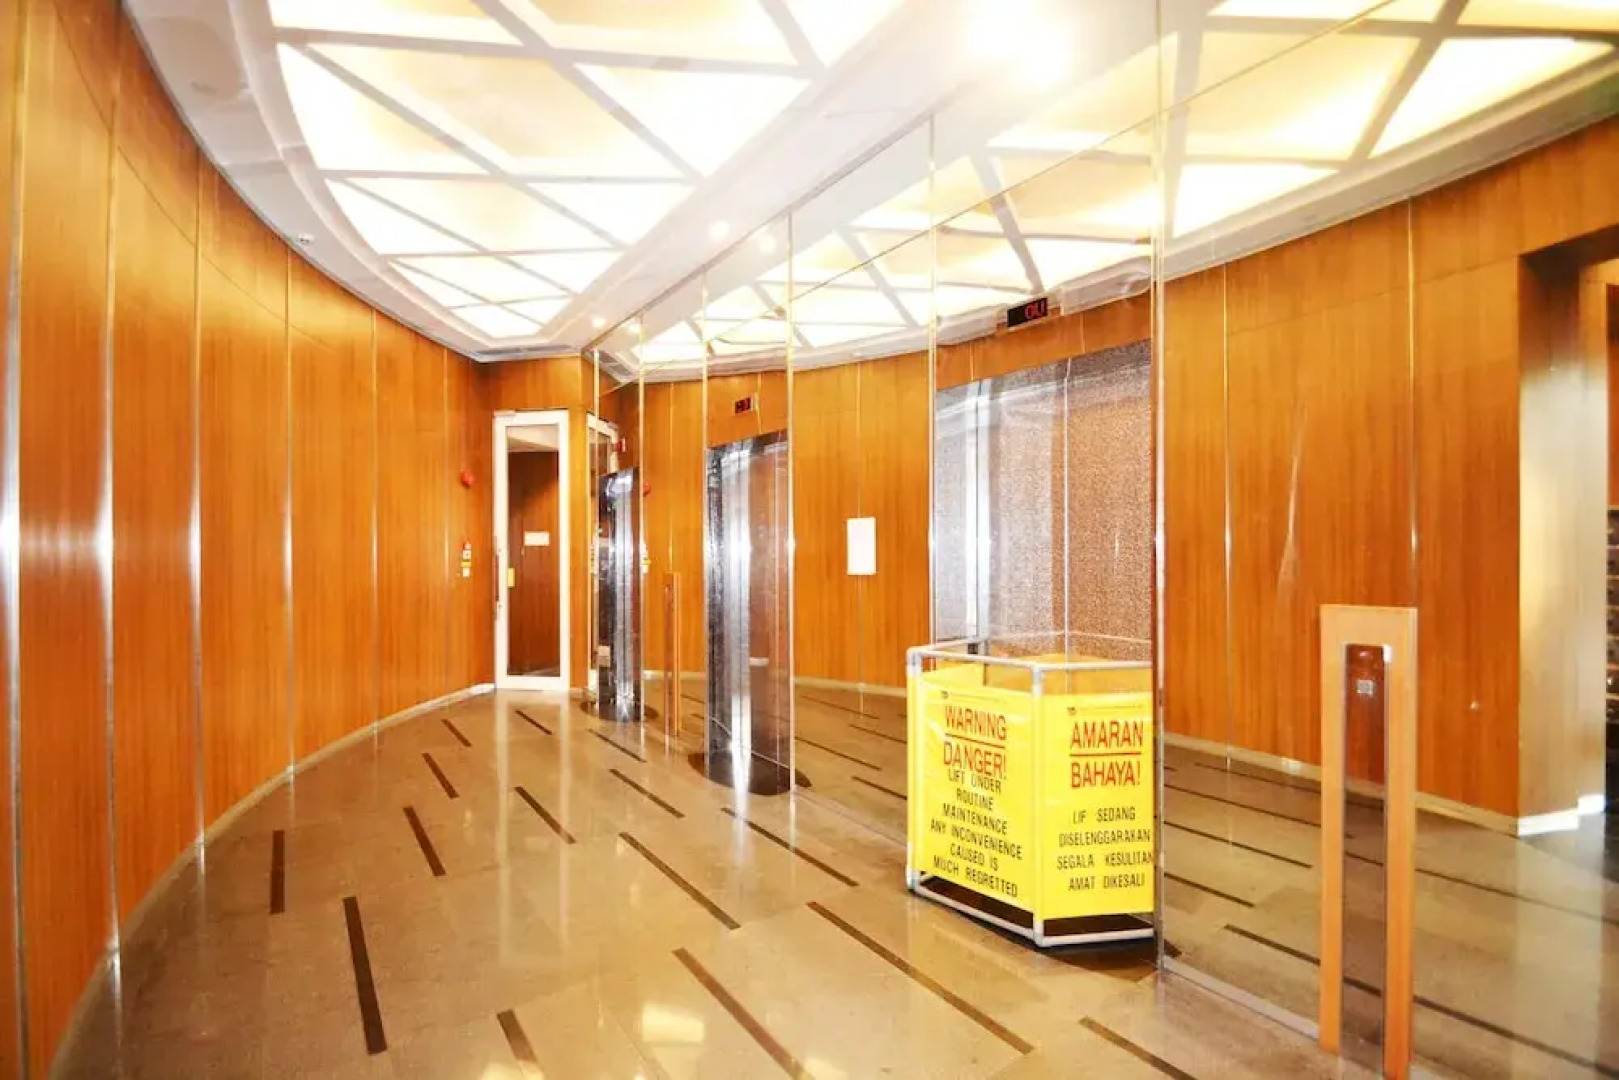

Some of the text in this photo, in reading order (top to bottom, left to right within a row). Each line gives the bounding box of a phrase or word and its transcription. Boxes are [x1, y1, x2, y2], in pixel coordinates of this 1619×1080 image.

[944, 705, 1007, 741] WARNING
[1069, 720, 1143, 748] AMARAN
[943, 741, 1007, 780] DANGER!
[1070, 760, 1141, 788] BAHAYA!
[948, 768, 1002, 794] LIFT UNDER
[956, 787, 994, 811] ROUTINE
[942, 802, 1008, 836] MAINTENANCE
[1072, 806, 1136, 825] LIF SEDANG
[930, 818, 1023, 861] ANY INCONVENIENCE
[1058, 828, 1151, 848] DISELENGGARAKAN
[950, 843, 998, 872] CAUSED IS
[1056, 854, 1095, 871] SEGALA
[933, 855, 1018, 898] MUCH REGRETTED
[1068, 872, 1146, 891] AMAT DIKESALI
